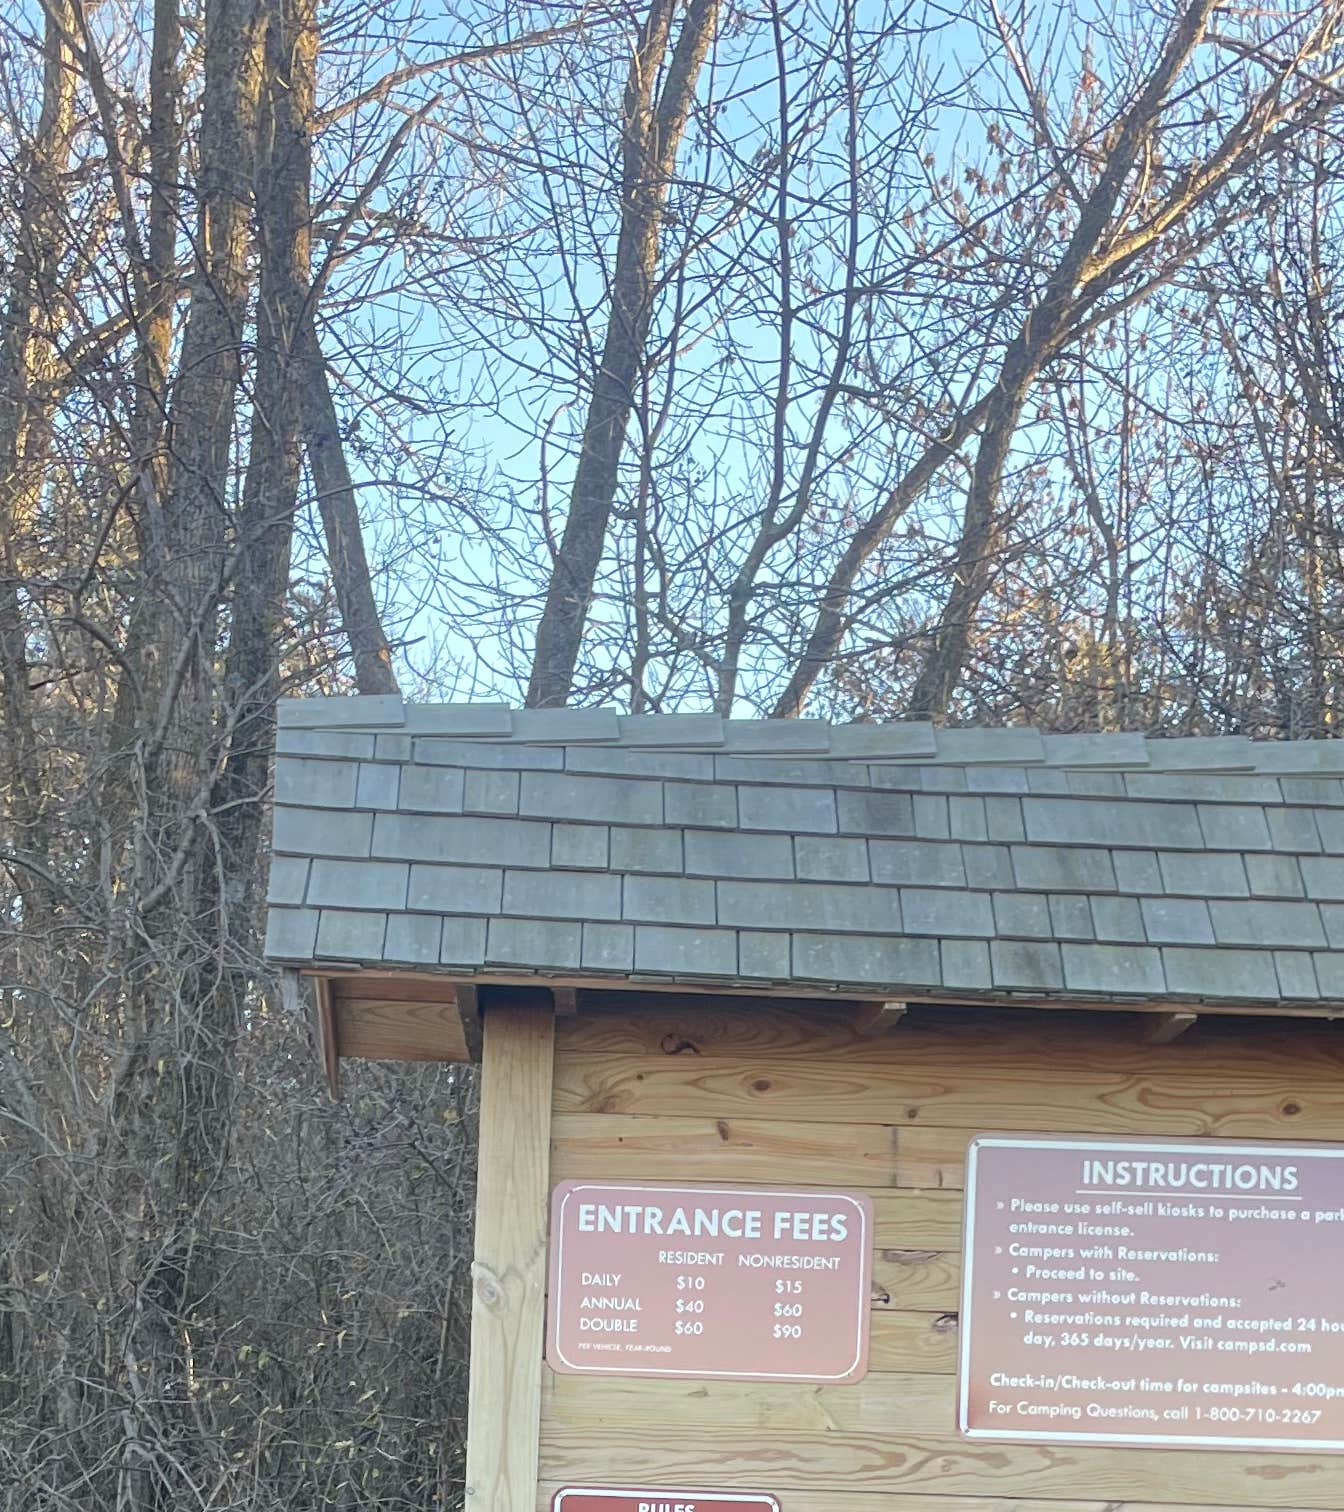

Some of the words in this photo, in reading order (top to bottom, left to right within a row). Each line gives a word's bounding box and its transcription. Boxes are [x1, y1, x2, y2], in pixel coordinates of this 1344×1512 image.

[1083, 1160, 1298, 1190] INSTRUCTIONS
[1011, 1199, 1059, 1213] Please
[1064, 1203, 1090, 1214] use
[1095, 1201, 1152, 1216] self-sell
[1158, 1202, 1204, 1218] kiosks
[1209, 1206, 1223, 1217] to
[1229, 1207, 1296, 1221] purchase
[1301, 1210, 1310, 1220] a
[578, 1204, 761, 1238] ENTRANCE
[773, 1212, 848, 1242] FEES
[1009, 1223, 1073, 1234] entrance
[1078, 1222, 1134, 1237] license.
[659, 1251, 725, 1265] RESIDENT
[738, 1254, 841, 1270] NONRESIDENT
[1009, 1243, 1074, 1260] Campers
[1080, 1246, 1112, 1259] with
[1118, 1247, 1219, 1263] Reservations:
[581, 1273, 621, 1286] DAILY
[677, 1276, 705, 1290] $10
[775, 1279, 802, 1294] $15
[1026, 1265, 1085, 1280] Proceed
[1090, 1267, 1104, 1280] to
[1109, 1268, 1140, 1282] site.
[580, 1297, 642, 1312] ANNUAL
[675, 1300, 704, 1314] $40
[773, 1303, 802, 1318] $60
[1008, 1289, 1073, 1305] Campers
[1078, 1291, 1135, 1304] without
[1140, 1292, 1241, 1308] Reservations:
[580, 1318, 638, 1333] DOUBLE
[675, 1321, 703, 1336] $60
[773, 1325, 802, 1339] $90
[1025, 1310, 1120, 1325] Reservations
[1126, 1313, 1188, 1329] required
[1194, 1316, 1222, 1329] and
[1227, 1317, 1292, 1332] accepted
[1297, 1318, 1316, 1331] 24
[1024, 1332, 1055, 1347] day,
[1061, 1333, 1089, 1346] 365
[1094, 1333, 1174, 1350] days/year.
[1181, 1336, 1213, 1350] Visit
[1218, 1338, 1311, 1354] campsd.com
[990, 1373, 1136, 1391] Check-in/Check-out
[1140, 1378, 1173, 1392] time
[1177, 1379, 1198, 1393] for
[1203, 1382, 1277, 1397] campsites
[989, 1400, 1013, 1414] For
[1017, 1401, 1081, 1419] Camping
[1086, 1403, 1159, 1421] Questions,
[1163, 1407, 1188, 1419] call
[1195, 1407, 1322, 1424] 1-800-710-2267
